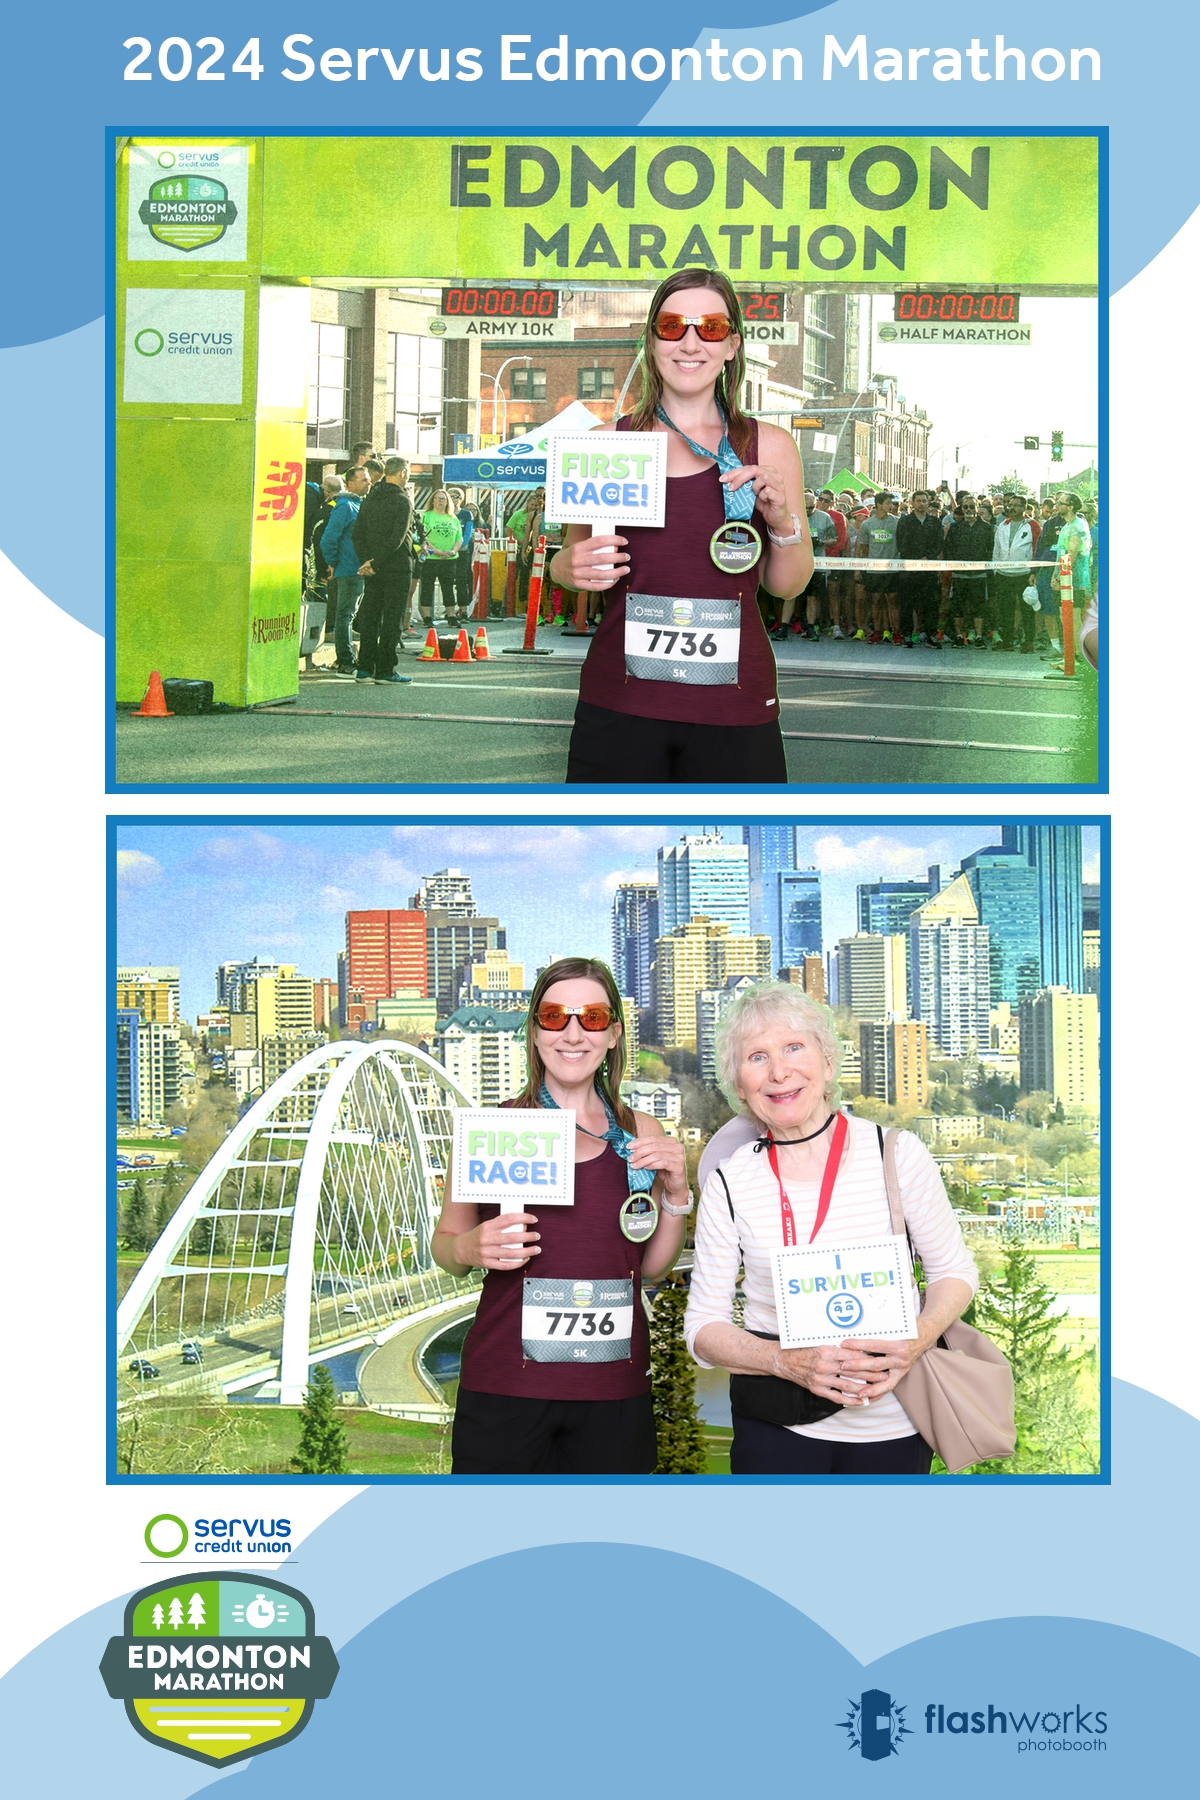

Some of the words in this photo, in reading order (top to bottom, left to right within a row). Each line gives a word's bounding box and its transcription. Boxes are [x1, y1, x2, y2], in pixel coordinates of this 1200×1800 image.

[178, 152, 220, 161] servus
[450, 145, 991, 211] EDMONTON
[149, 203, 227, 214] EDMONTON
[160, 214, 215, 222] MARATHON
[523, 223, 908, 271] MARATHON
[465, 321, 518, 336] ARMY
[521, 322, 554, 336] 10K
[900, 328, 939, 340] HALF
[942, 329, 1030, 341] MARATHON
[167, 331, 233, 345] servus
[168, 345, 200, 355] credit
[202, 346, 233, 355] union
[496, 465, 545, 475] servus
[561, 452, 652, 479] FIRST
[561, 481, 649, 508] RACE!
[258, 613, 290, 643] Running
[646, 628, 718, 658] 7736
[672, 669, 687, 678] 5K
[467, 1130, 560, 1157] FIRST
[468, 1159, 557, 1186] RACE!
[835, 1254, 842, 1270] I
[788, 1270, 895, 1295] SURVIVED!
[546, 1312, 615, 1336] 7736
[573, 1349, 588, 1358] 5K
